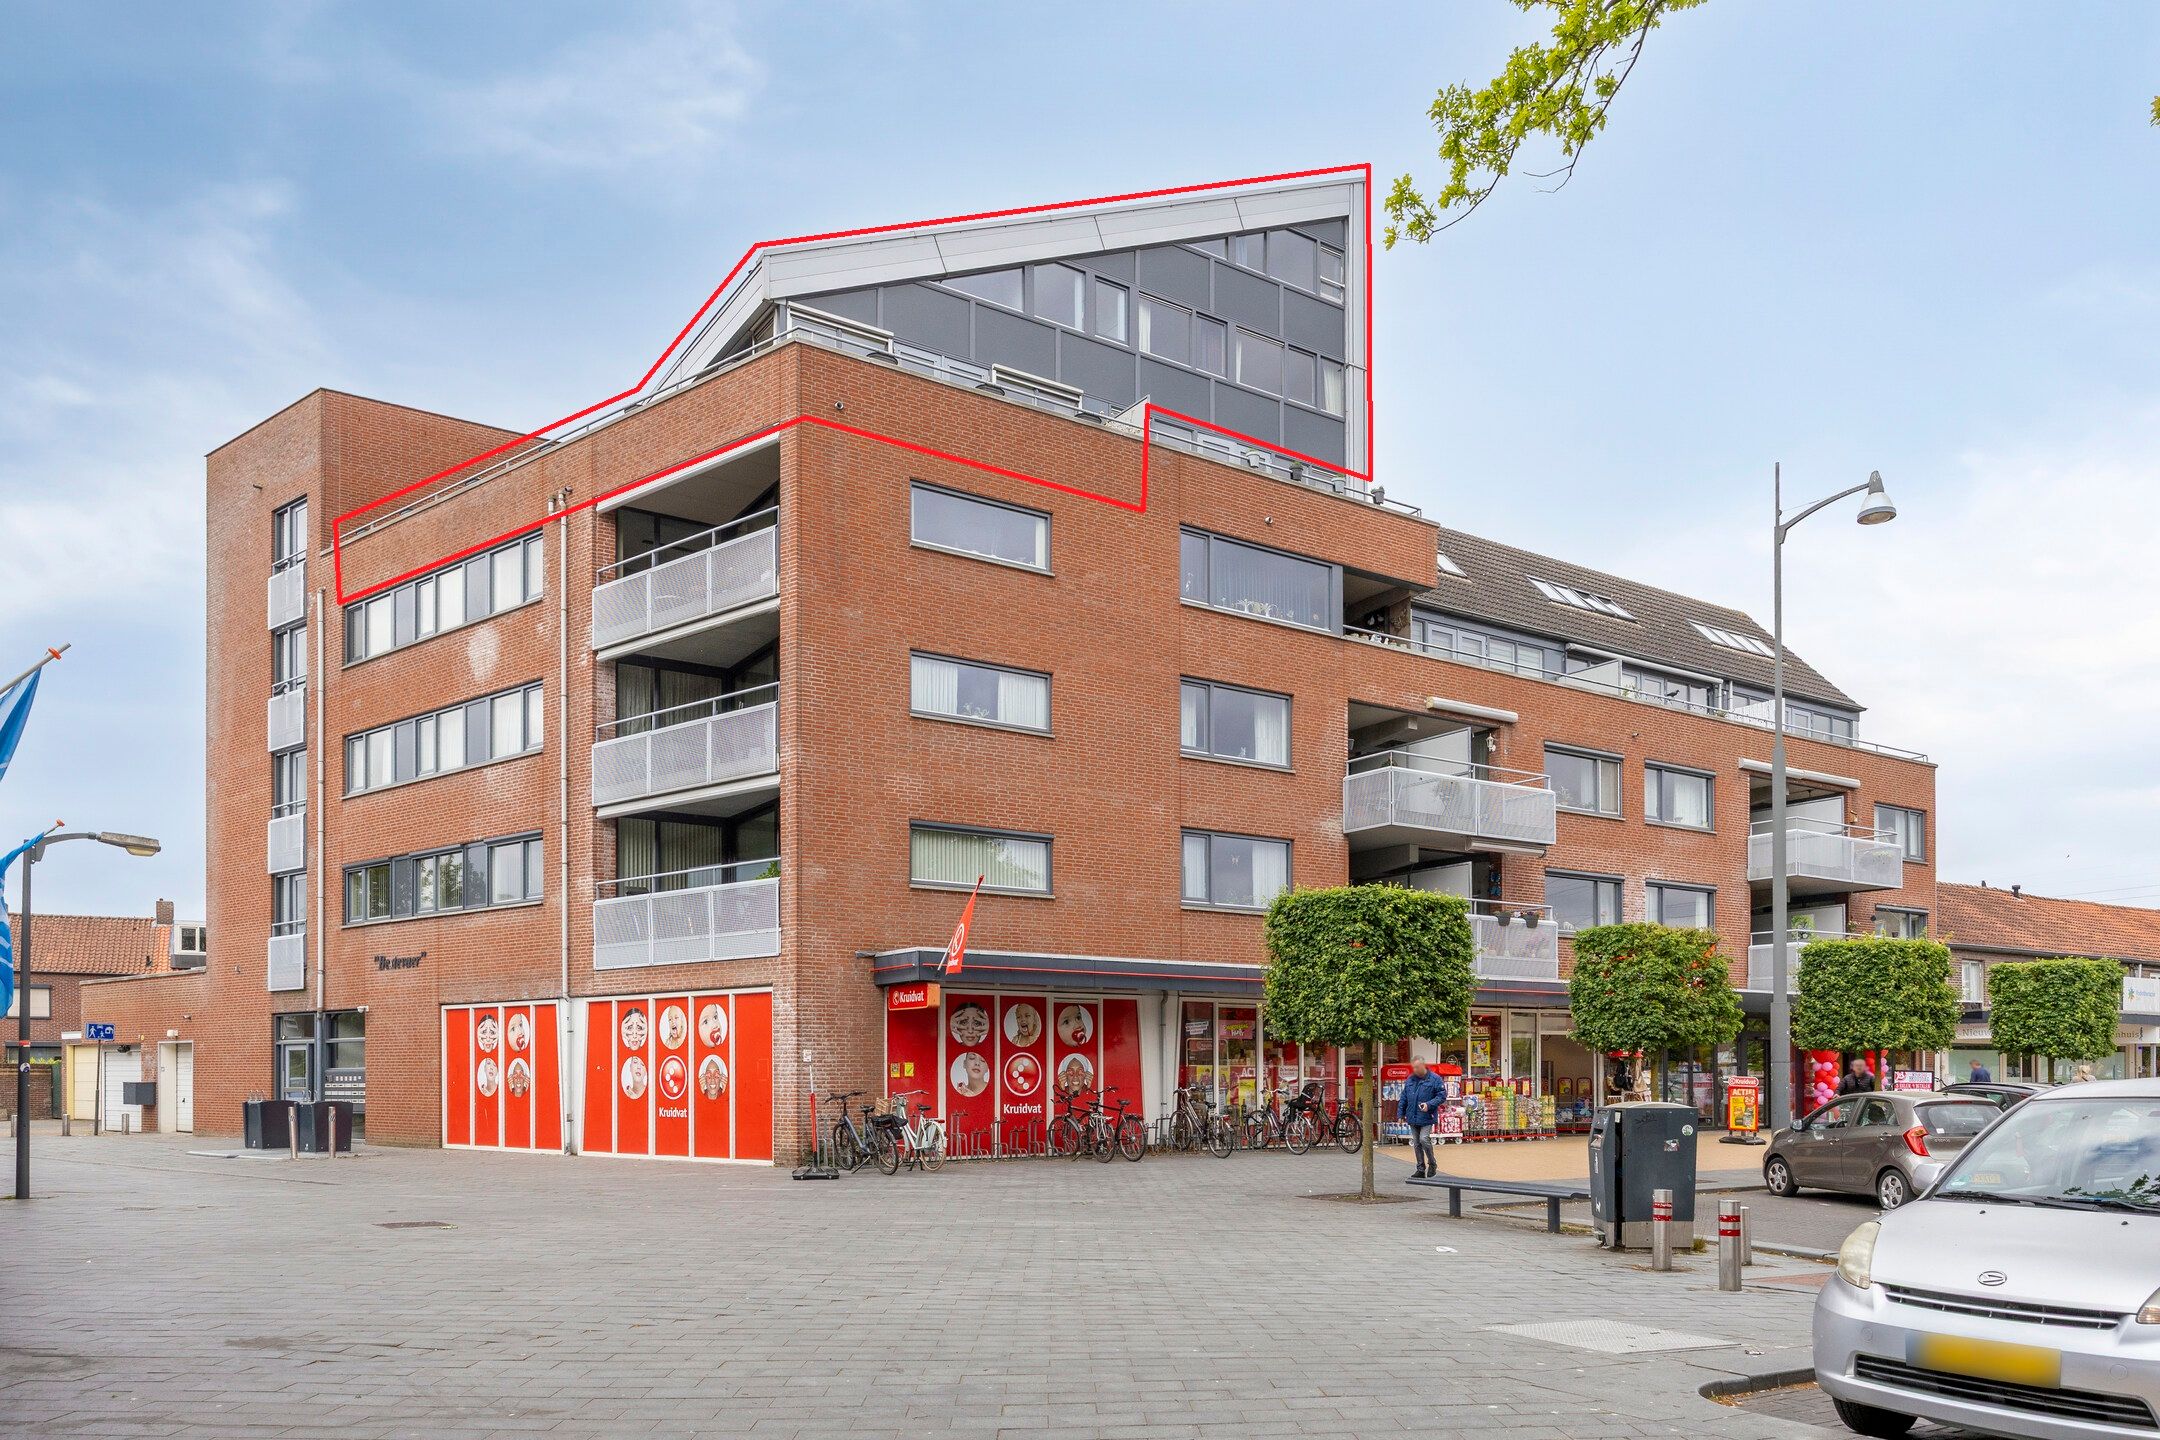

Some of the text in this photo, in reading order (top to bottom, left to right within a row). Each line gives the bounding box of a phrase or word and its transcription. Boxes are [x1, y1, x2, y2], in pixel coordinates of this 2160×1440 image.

[899, 990, 924, 1003] Kruidvat
[659, 1107, 688, 1117] Kruidvat
[1003, 1103, 1042, 1114] Kruidvat
